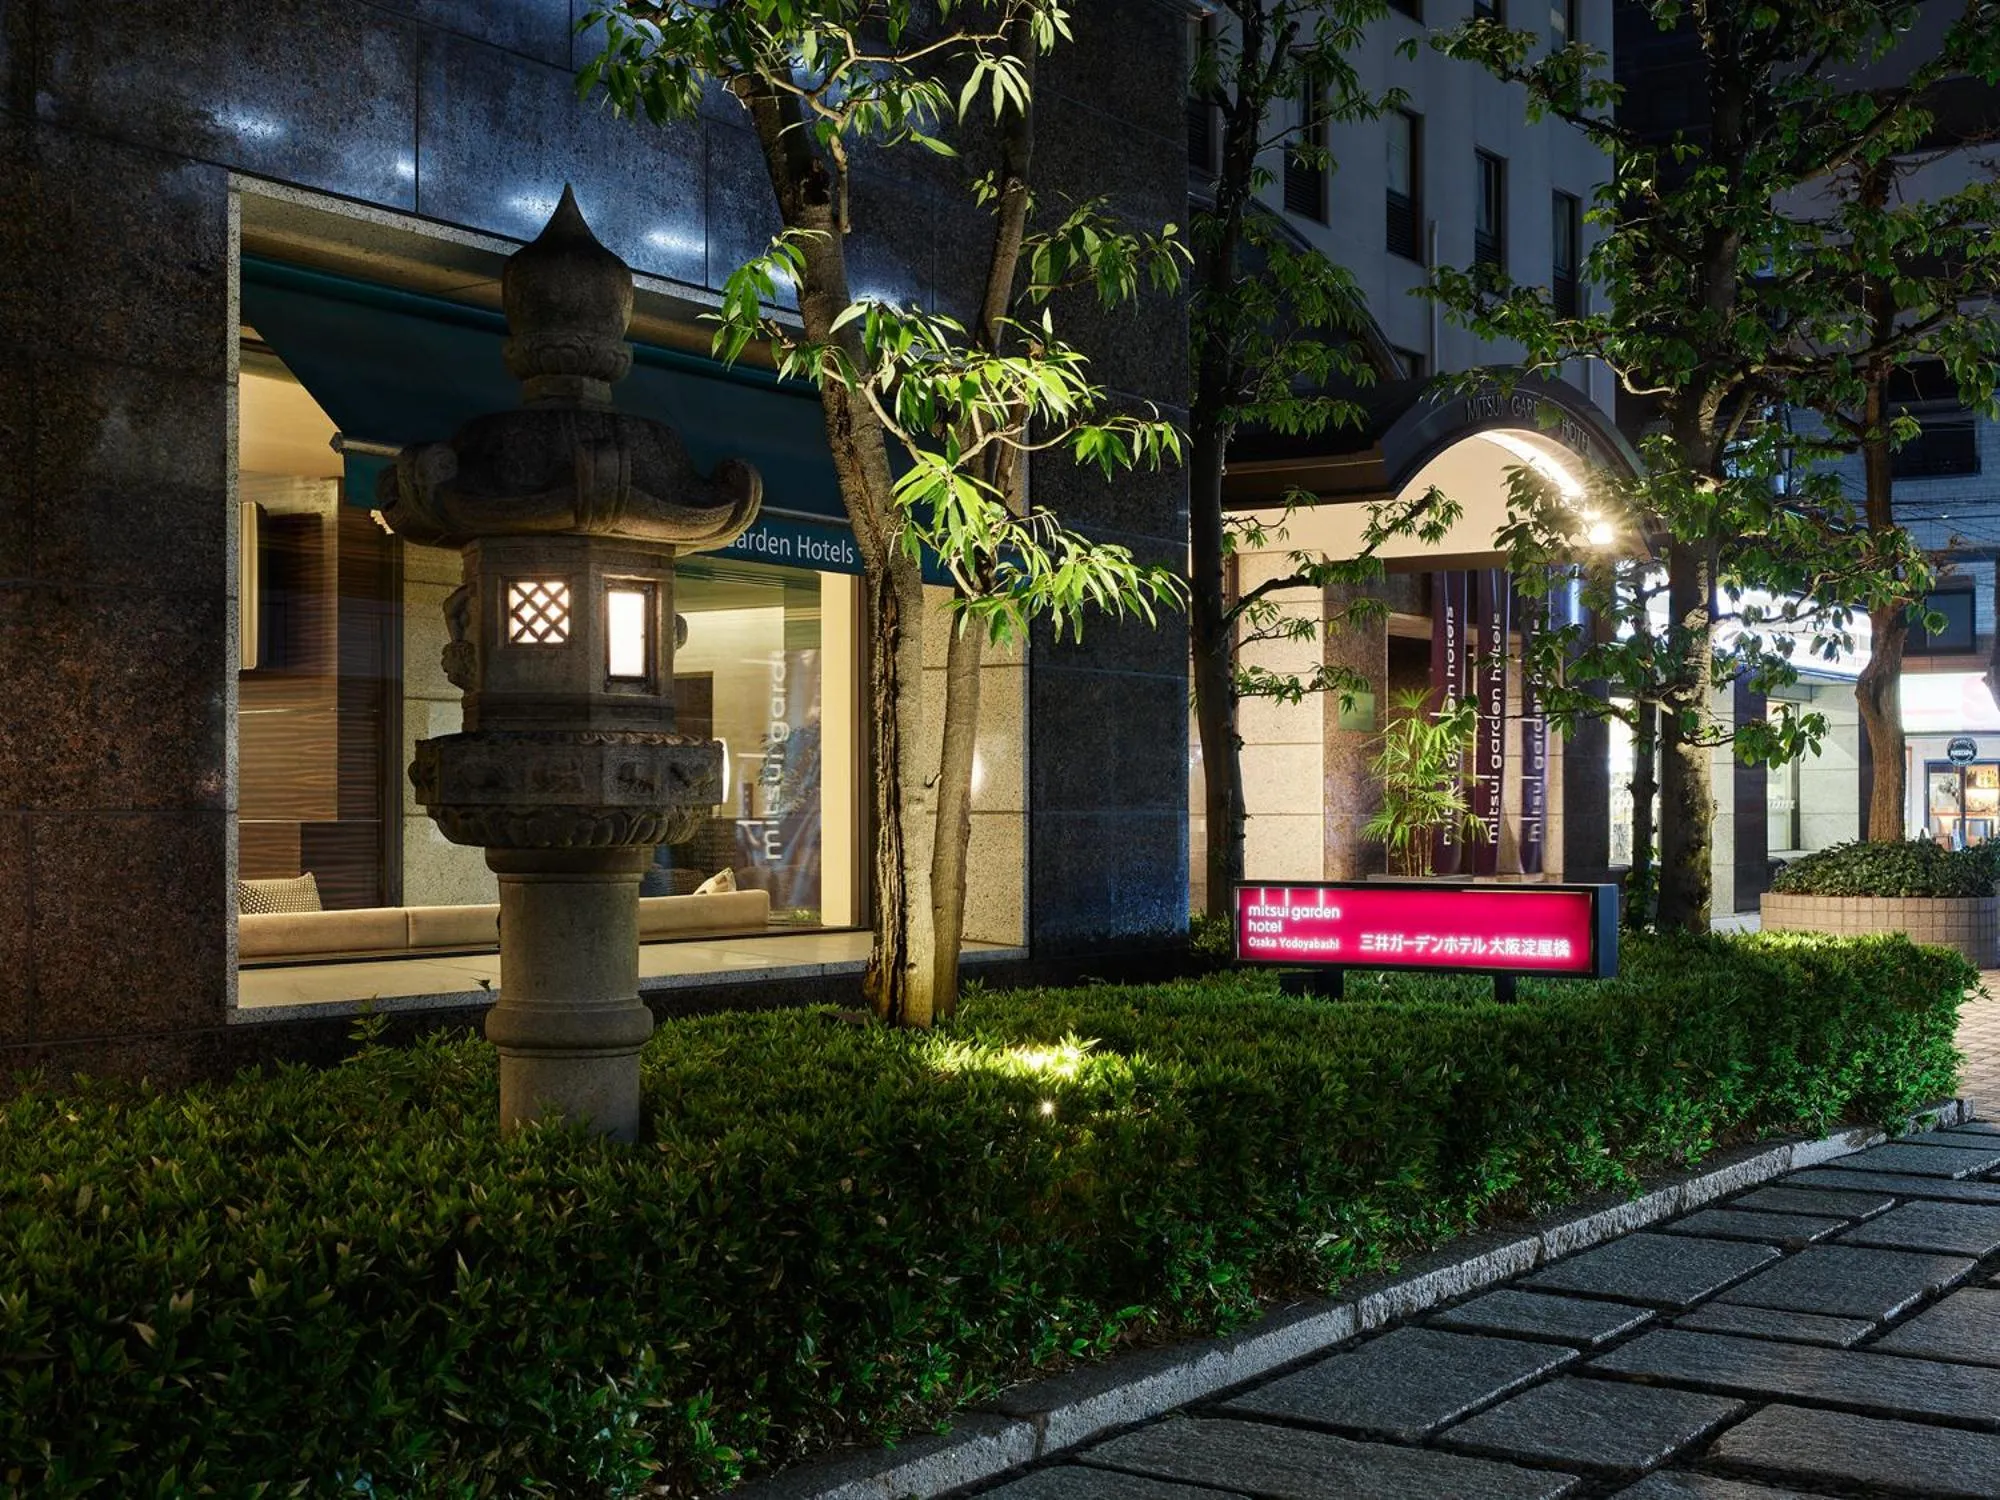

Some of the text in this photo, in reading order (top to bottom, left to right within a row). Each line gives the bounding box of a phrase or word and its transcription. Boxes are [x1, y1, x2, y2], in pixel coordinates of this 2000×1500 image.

[1562, 416, 1592, 454] HOTEL
[727, 527, 854, 564] arden Hotels
[1485, 687, 1502, 769] garden
[1484, 775, 1500, 844] mitsui
[1527, 775, 1543, 842] mitsui
[1248, 899, 1341, 921] mitsui garden
[1248, 919, 1282, 933] hotel
[1248, 937, 1341, 952] Osaka Yodoyabashi
